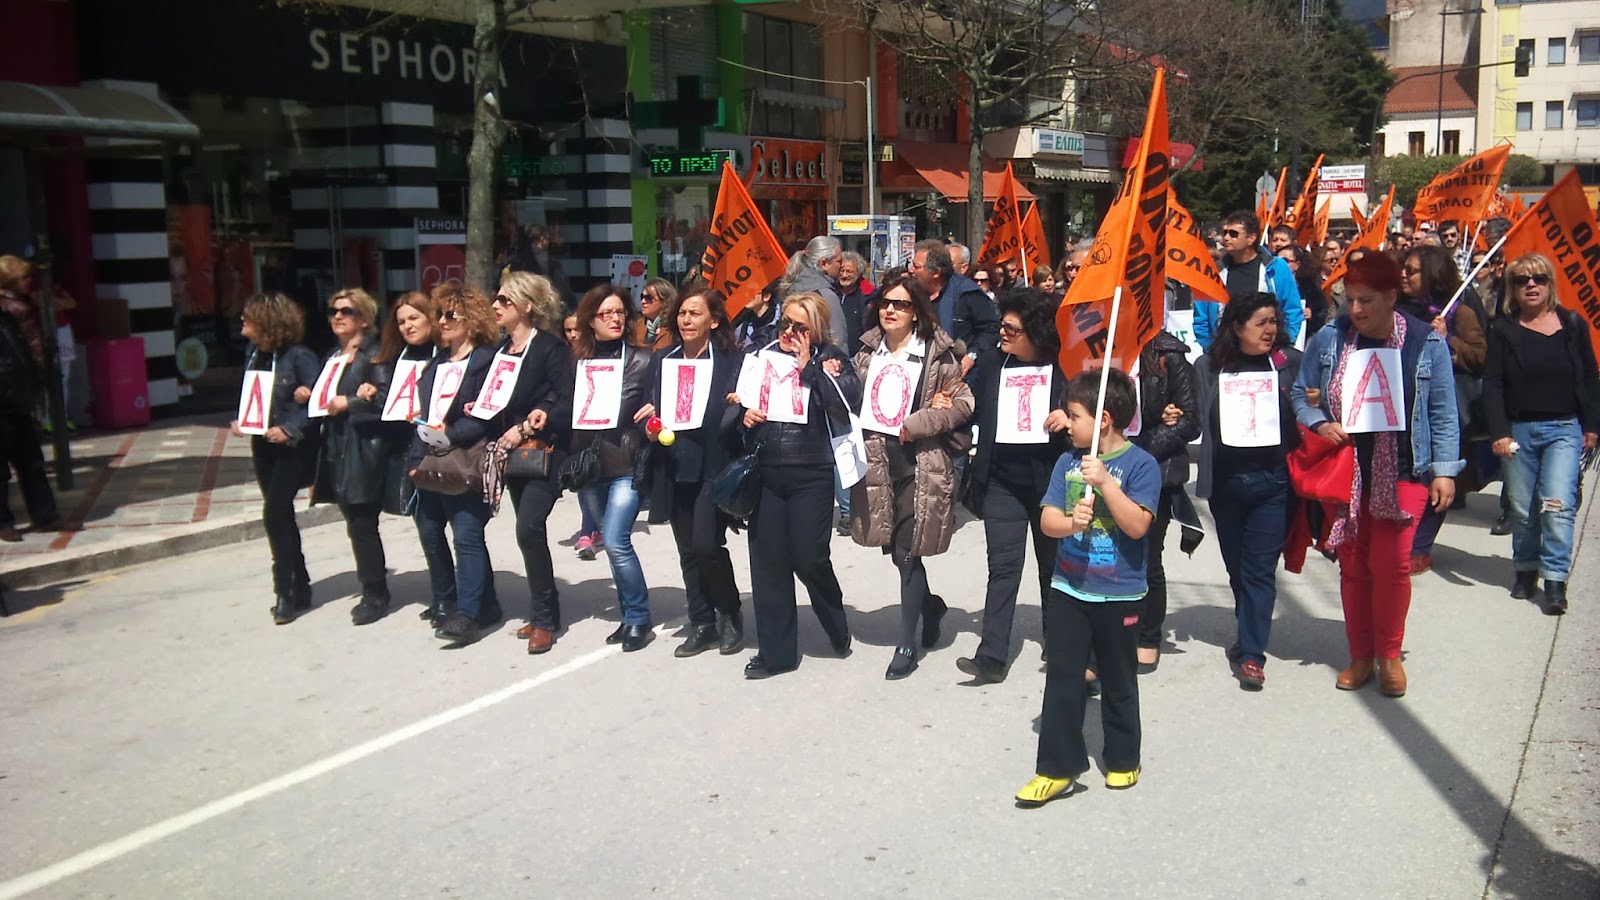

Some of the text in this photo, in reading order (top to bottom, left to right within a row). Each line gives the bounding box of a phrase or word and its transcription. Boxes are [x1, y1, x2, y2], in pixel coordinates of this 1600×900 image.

[752, 140, 826, 179] Select
[1055, 135, 1083, 152] ΕΛΠΙΣ
[419, 220, 465, 231] SEPHORA
[1167, 247, 1226, 289] ΟΛΜ
[1537, 203, 1600, 331] ΣΤΟΥΣ ΔΡΟΜΟ
